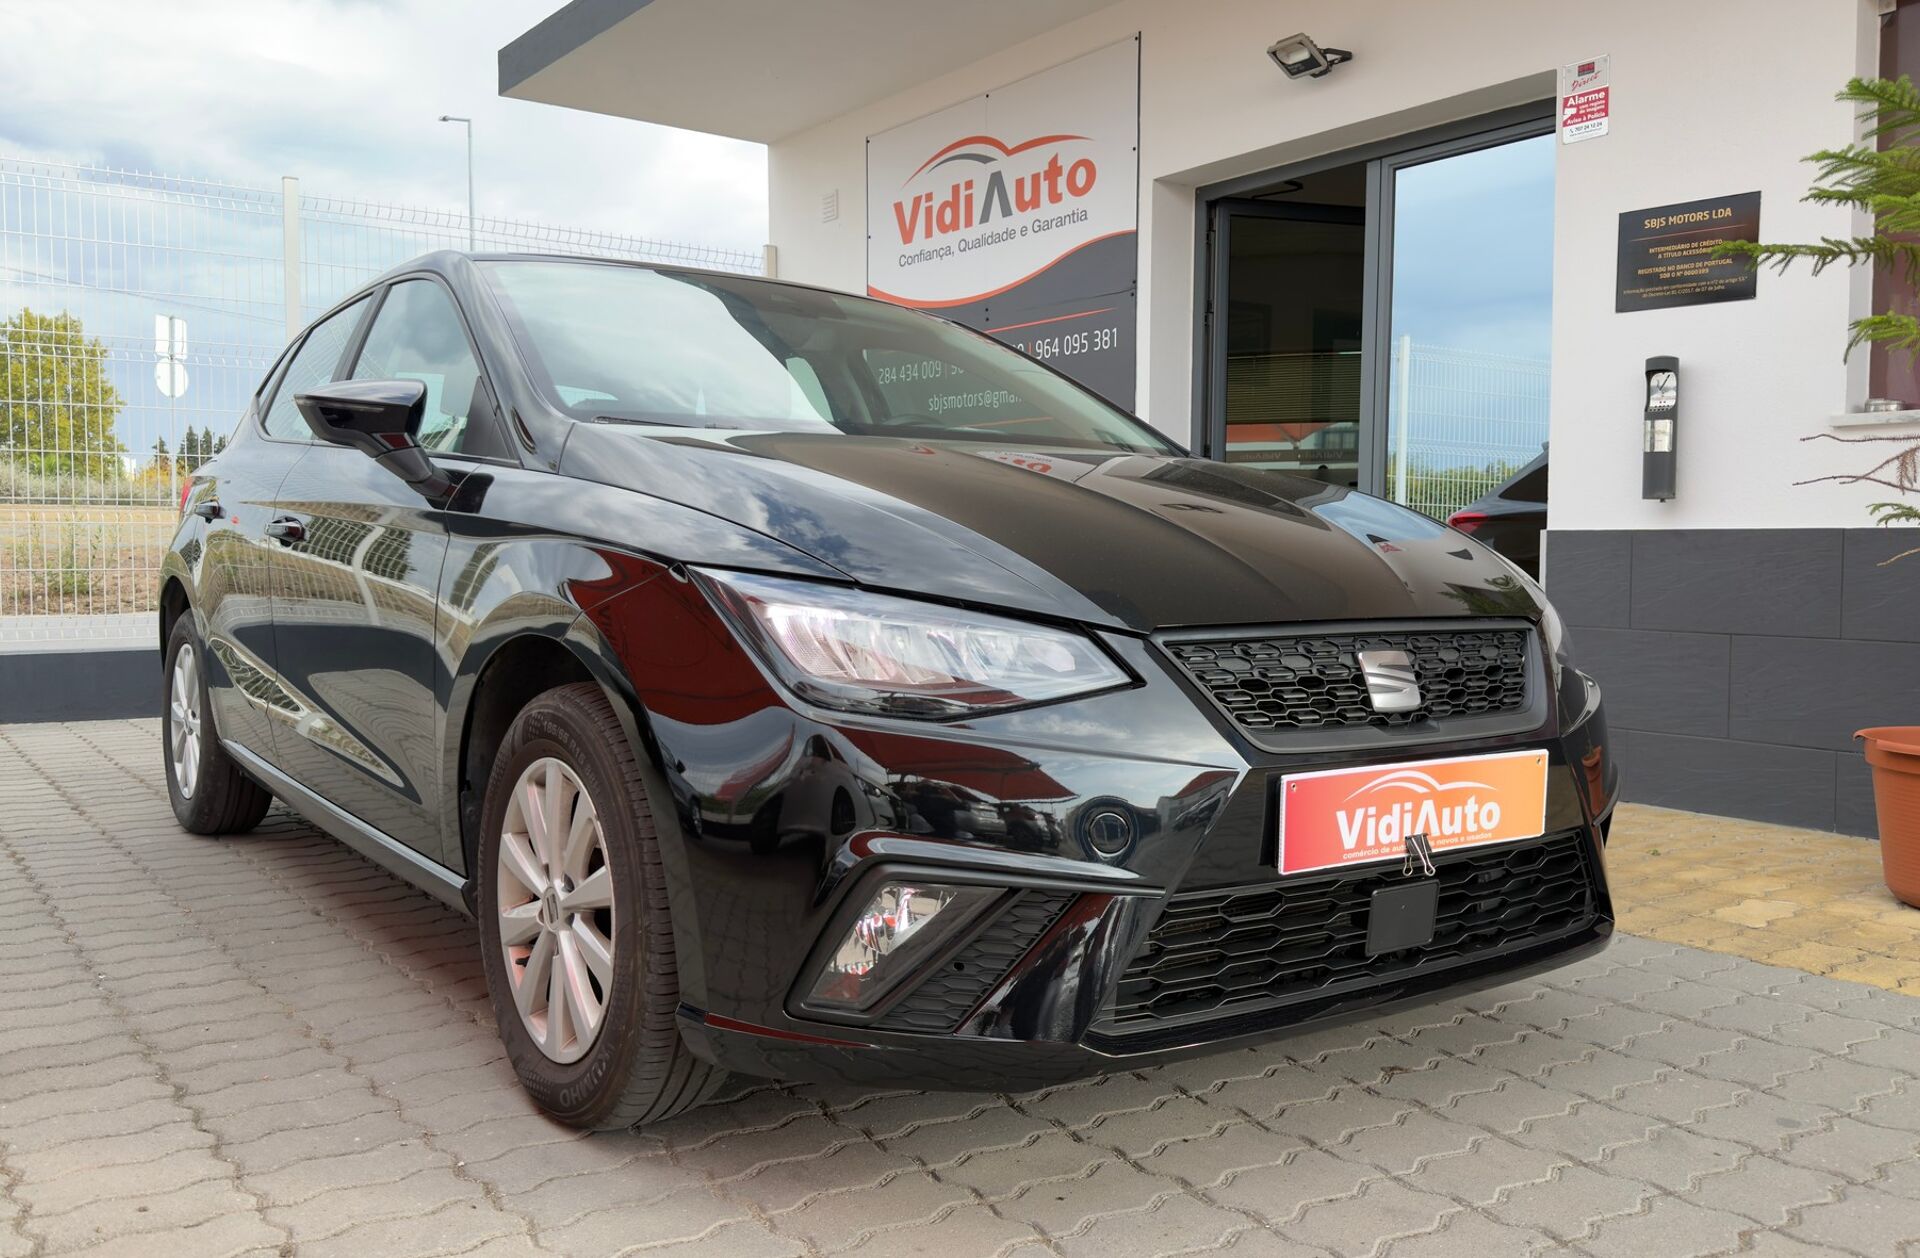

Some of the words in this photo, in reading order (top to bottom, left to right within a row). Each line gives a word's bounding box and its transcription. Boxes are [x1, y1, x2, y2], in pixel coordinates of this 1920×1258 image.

[1566, 90, 1606, 107] Alarme
[893, 152, 1096, 246] VidiAuto
[1644, 216, 1666, 229] SBJS
[1668, 211, 1710, 226] MOTORS
[1712, 207, 1732, 219] LDA
[899, 245, 954, 268] Confiança,
[958, 228, 1016, 252] Qualidade
[1020, 225, 1028, 237] e
[1032, 208, 1088, 234] Garantia
[1704, 258, 1733, 267] PORTUGAL
[1035, 337, 1060, 360] 964
[1064, 332, 1088, 356] 095
[1093, 327, 1118, 352] 381
[878, 368, 896, 384] 284
[900, 363, 918, 382] 434
[921, 361, 941, 379] 009
[1336, 795, 1501, 850] VidiAuto
[1343, 848, 1379, 860] comércio
[1436, 838, 1457, 846] novos
[1466, 832, 1492, 841] usados
